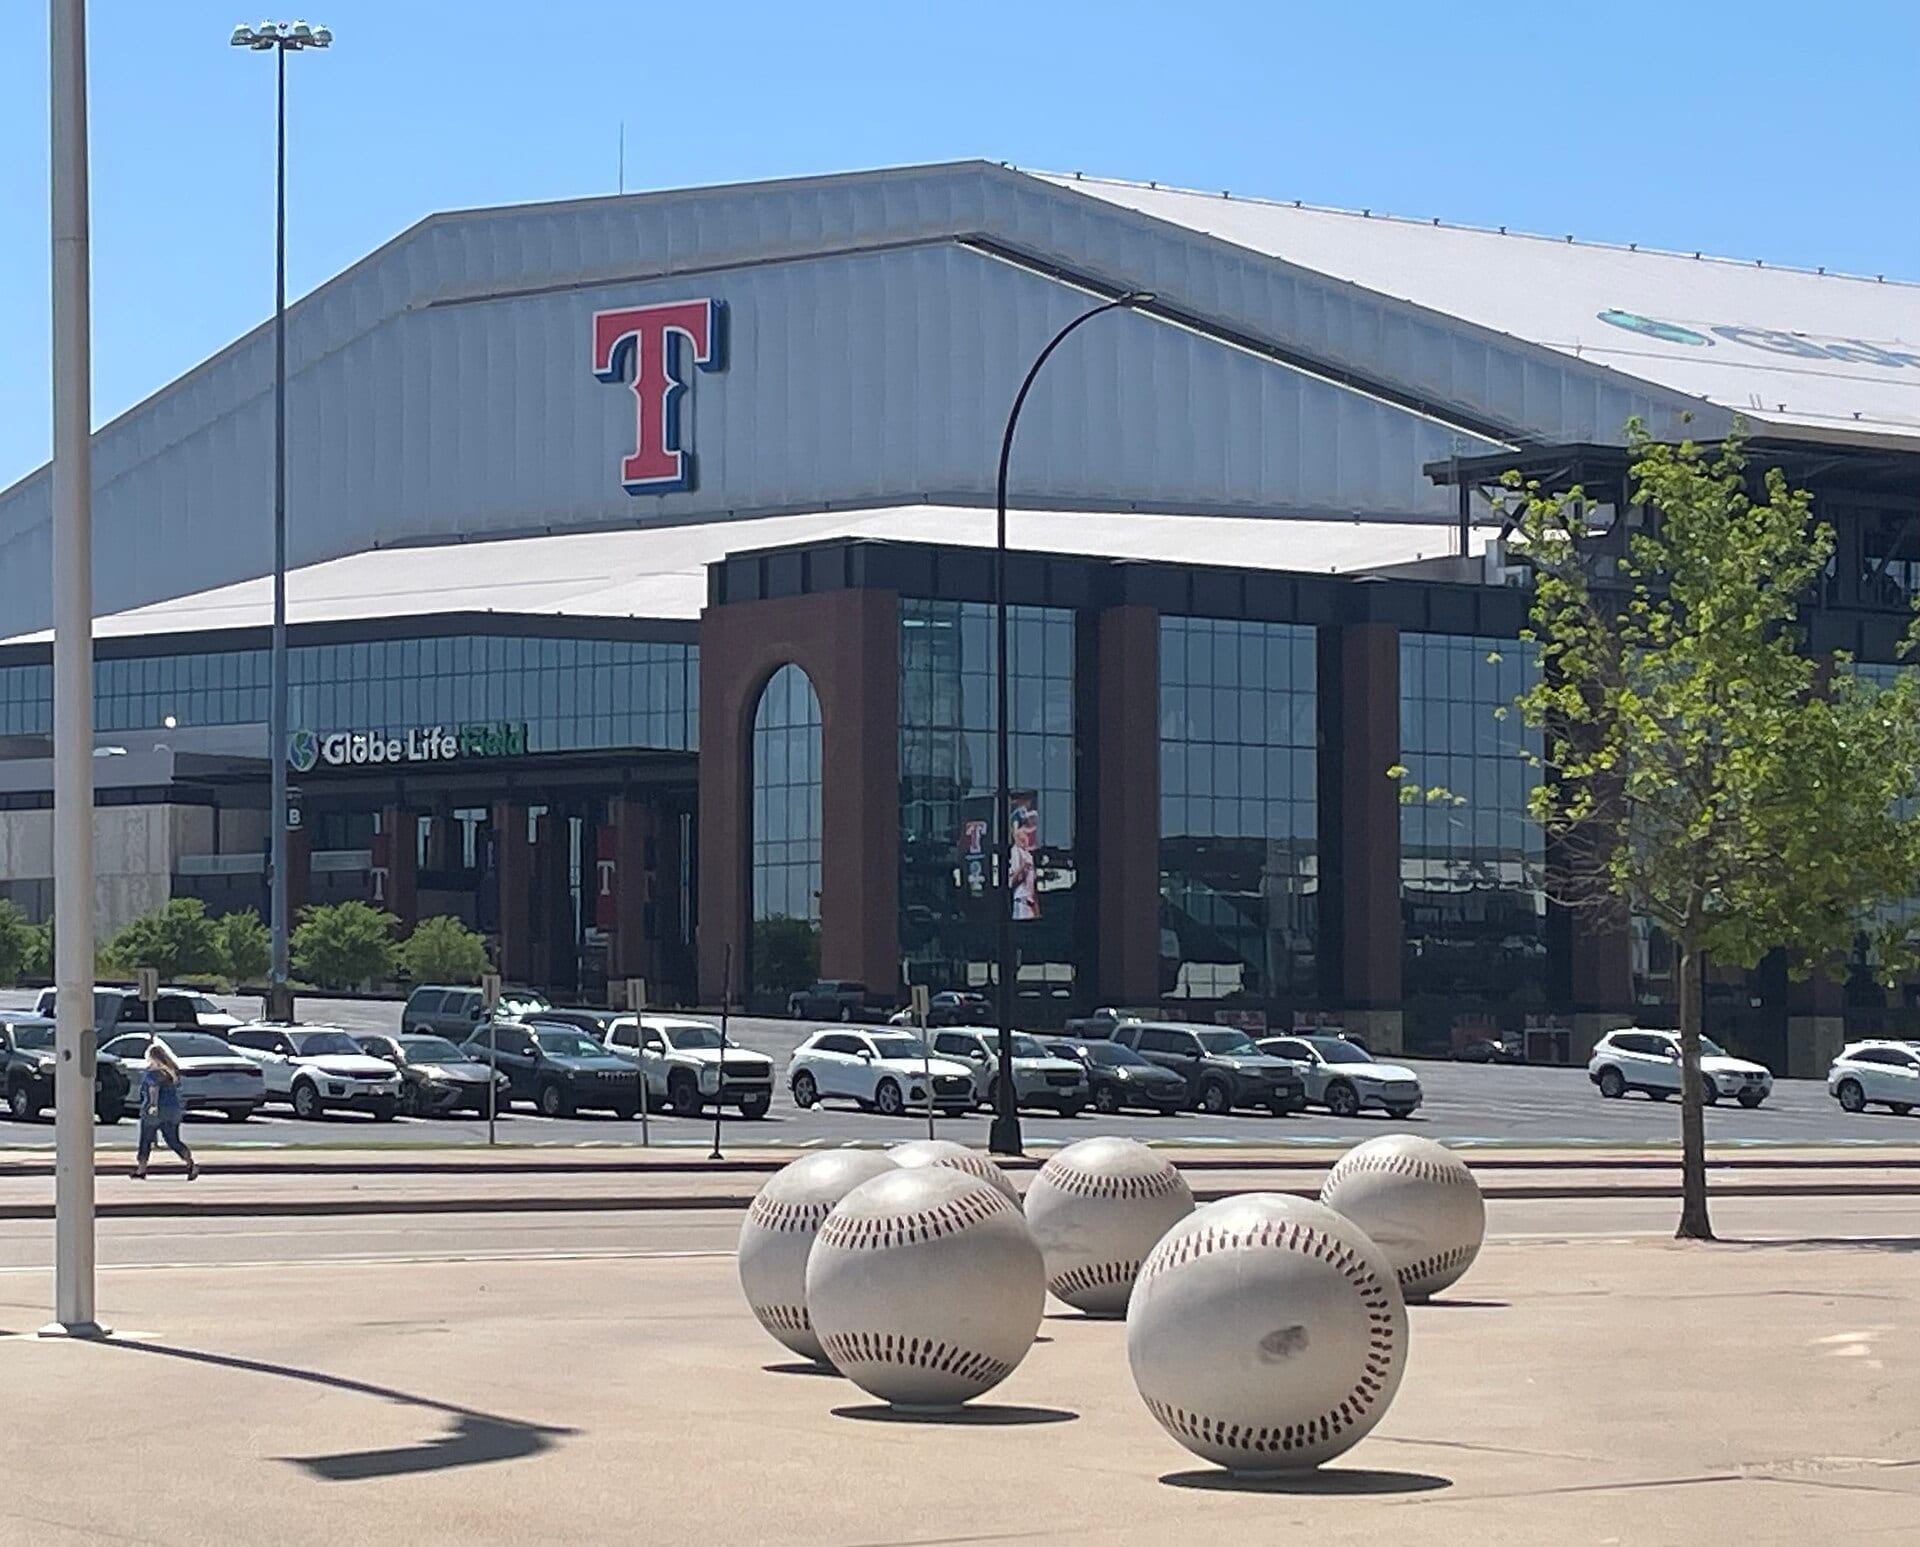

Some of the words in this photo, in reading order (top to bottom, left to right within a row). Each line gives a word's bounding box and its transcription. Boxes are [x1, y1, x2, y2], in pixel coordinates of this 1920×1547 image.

[593, 298, 721, 496] T
[323, 731, 401, 765] Globe
[408, 726, 457, 761] Life
[289, 809, 301, 825] B
[965, 821, 987, 853] T
[370, 867, 389, 901] T
[597, 860, 616, 896] T
